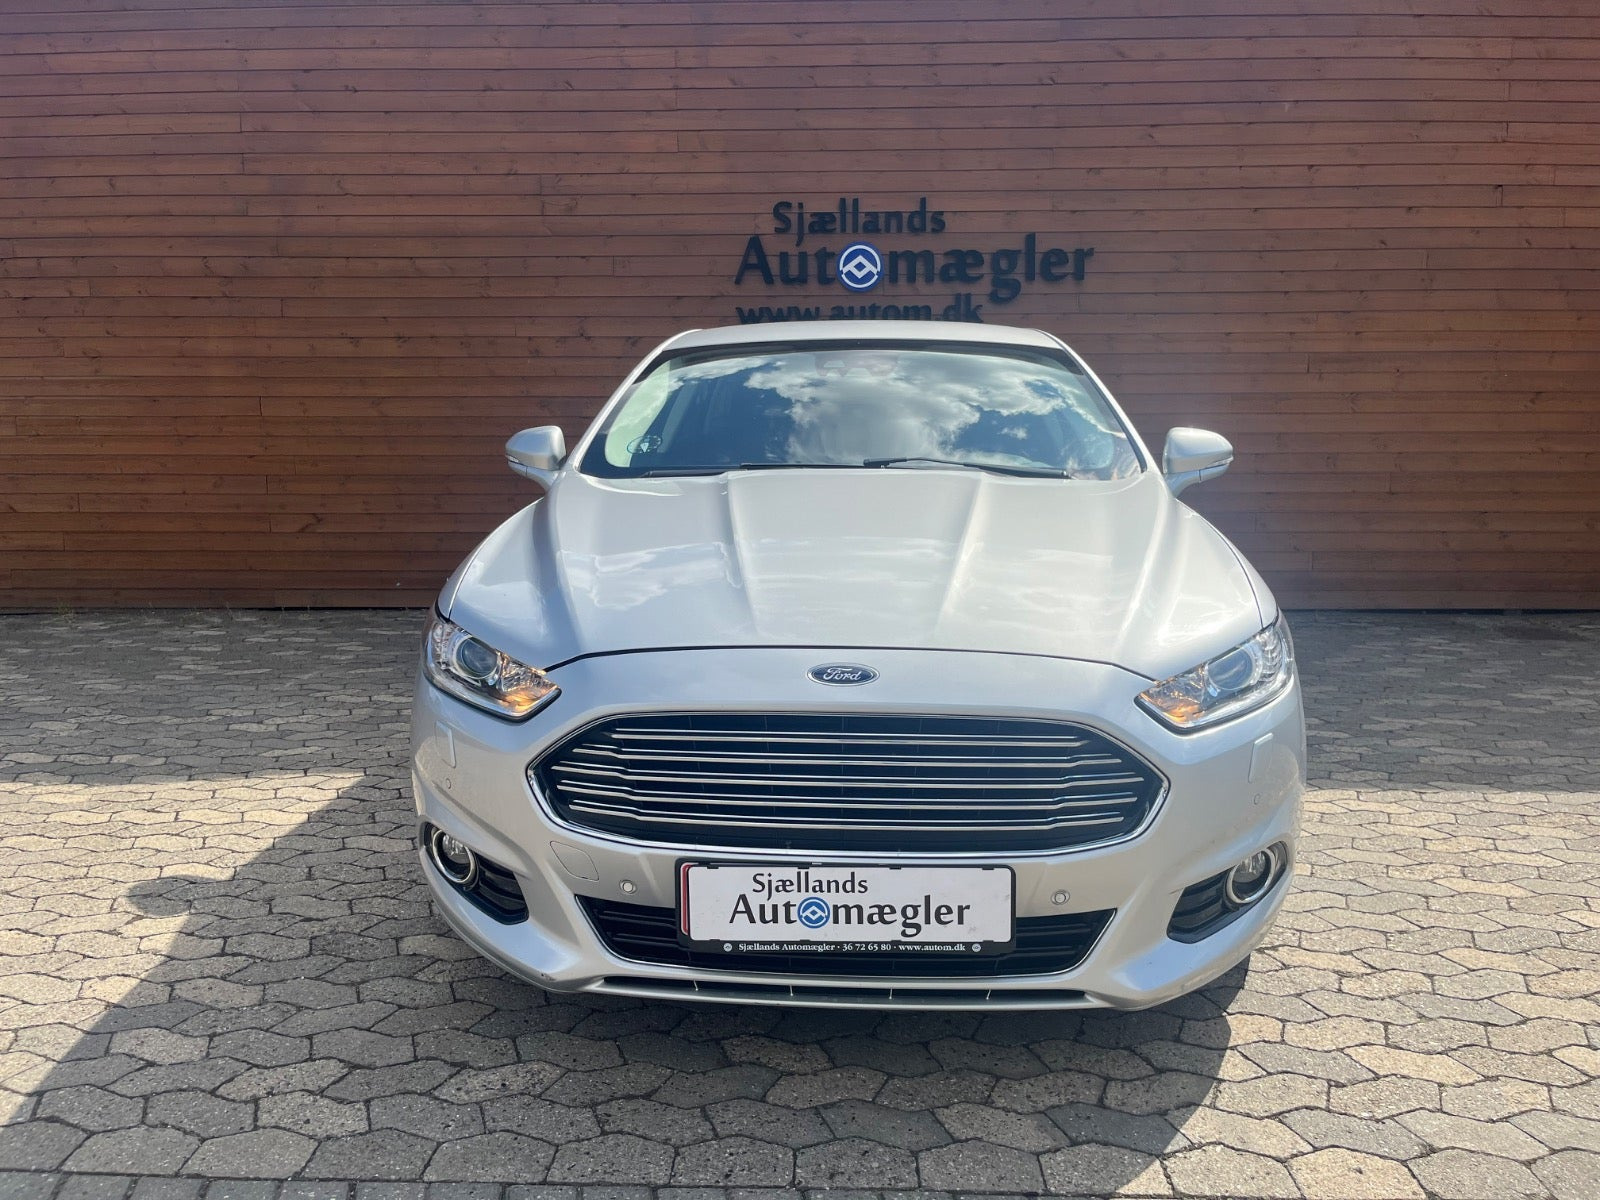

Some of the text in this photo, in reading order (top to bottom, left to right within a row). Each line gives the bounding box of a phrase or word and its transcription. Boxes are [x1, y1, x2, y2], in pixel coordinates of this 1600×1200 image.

[772, 197, 946, 246] Sjællands
[735, 292, 984, 325] wwwautom.dk
[823, 667, 861, 680] Ford
[752, 871, 868, 900] Sjællands
[738, 942, 966, 953] Sjællands Automægler 36 72 65 80 www.autom.dk
